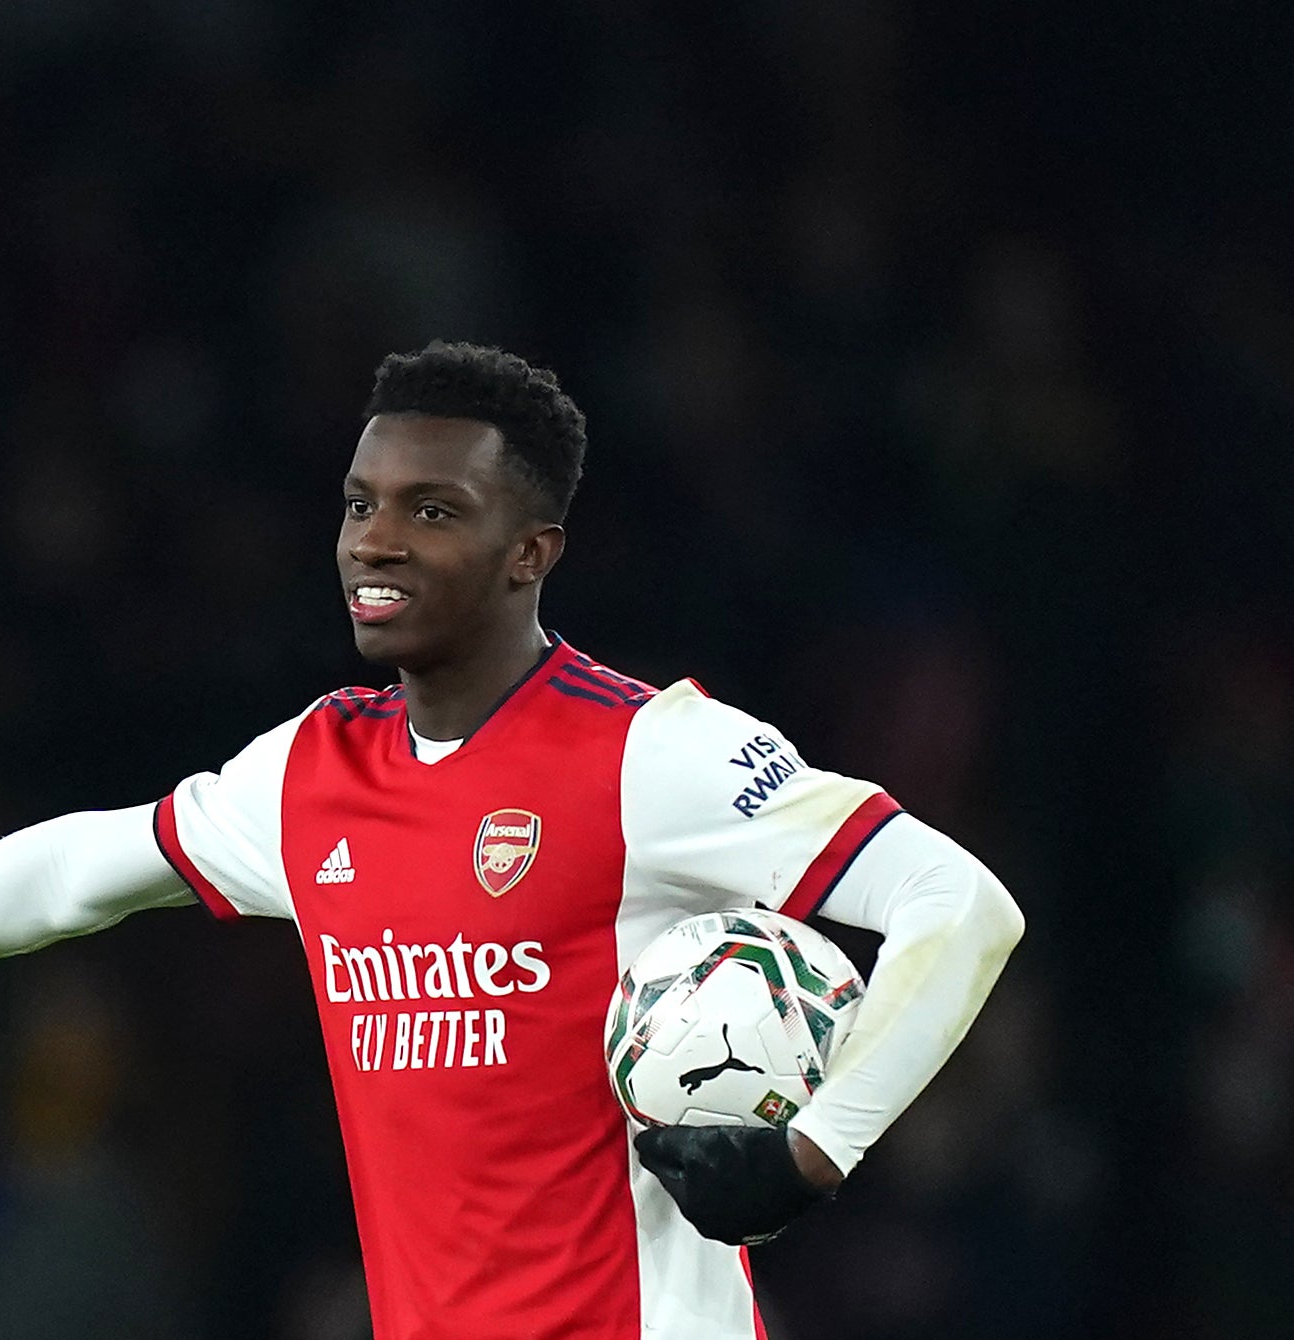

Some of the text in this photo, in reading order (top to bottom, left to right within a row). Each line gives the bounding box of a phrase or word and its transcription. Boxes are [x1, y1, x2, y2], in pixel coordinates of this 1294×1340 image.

[485, 823, 531, 838] Arsenal
[315, 867, 356, 884] adidas
[319, 928, 552, 1003] Emirates
[351, 1009, 508, 1072] FLY BETTER
